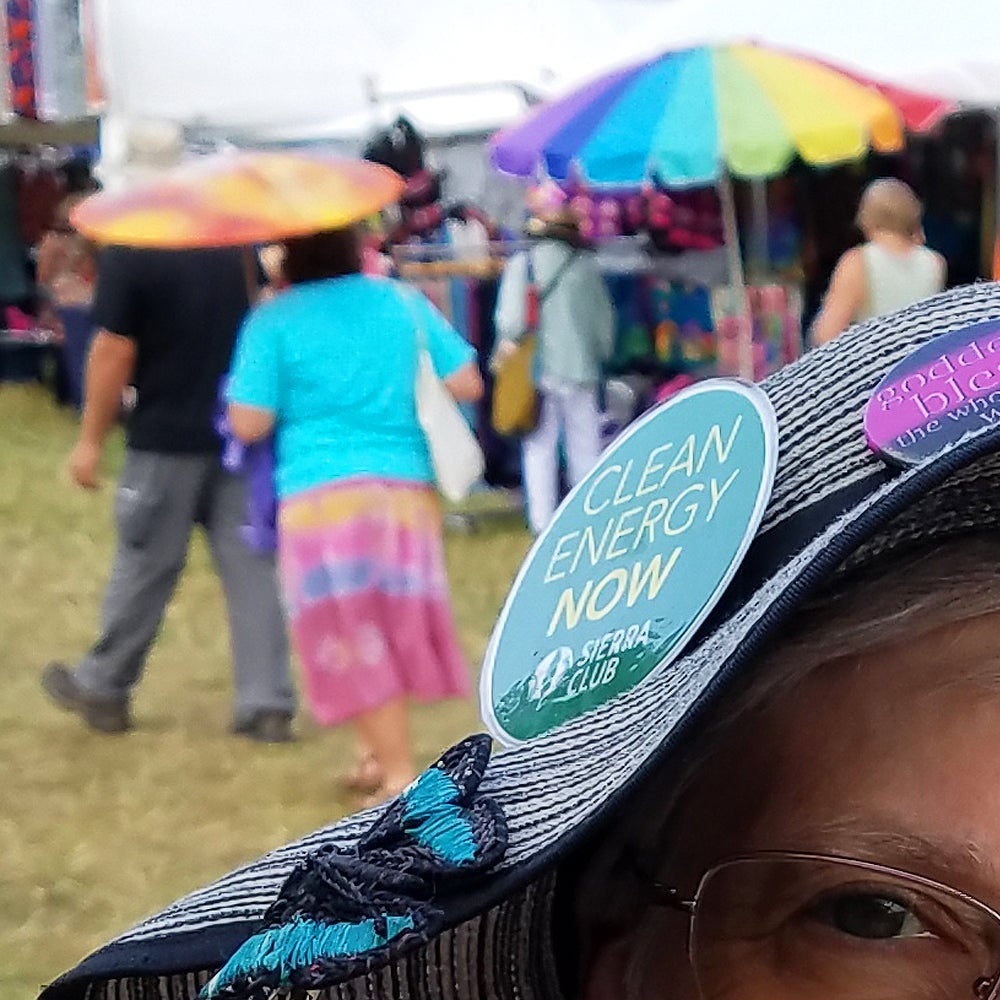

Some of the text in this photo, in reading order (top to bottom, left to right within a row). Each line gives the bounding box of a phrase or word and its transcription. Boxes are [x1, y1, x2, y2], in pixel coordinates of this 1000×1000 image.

[583, 414, 743, 516] CLEAN
[896, 418, 943, 448] the
[544, 468, 741, 584] ENERGY
[546, 547, 683, 638] NOW
[567, 656, 620, 697] CLUB
[577, 619, 652, 667] SIERRA
